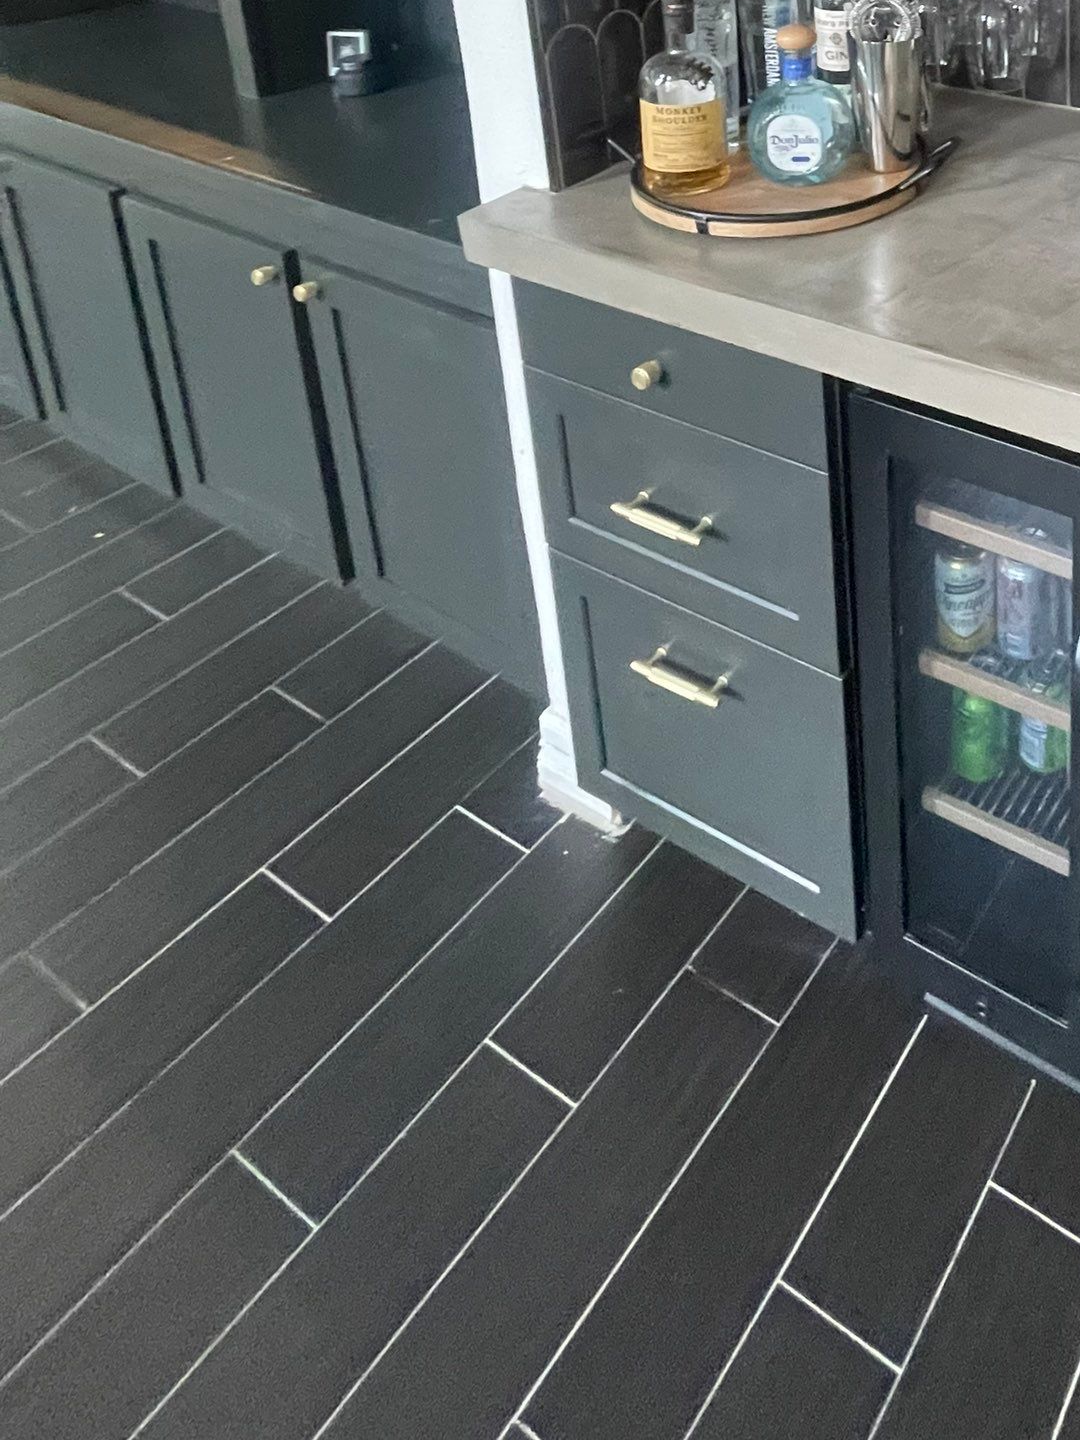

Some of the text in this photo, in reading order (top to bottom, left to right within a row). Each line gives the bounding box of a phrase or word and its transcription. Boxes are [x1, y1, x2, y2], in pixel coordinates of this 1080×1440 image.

[825, 50, 849, 60] GIN
[656, 106, 702, 115] MONKEY
[652, 115, 707, 125] SHOULDER
